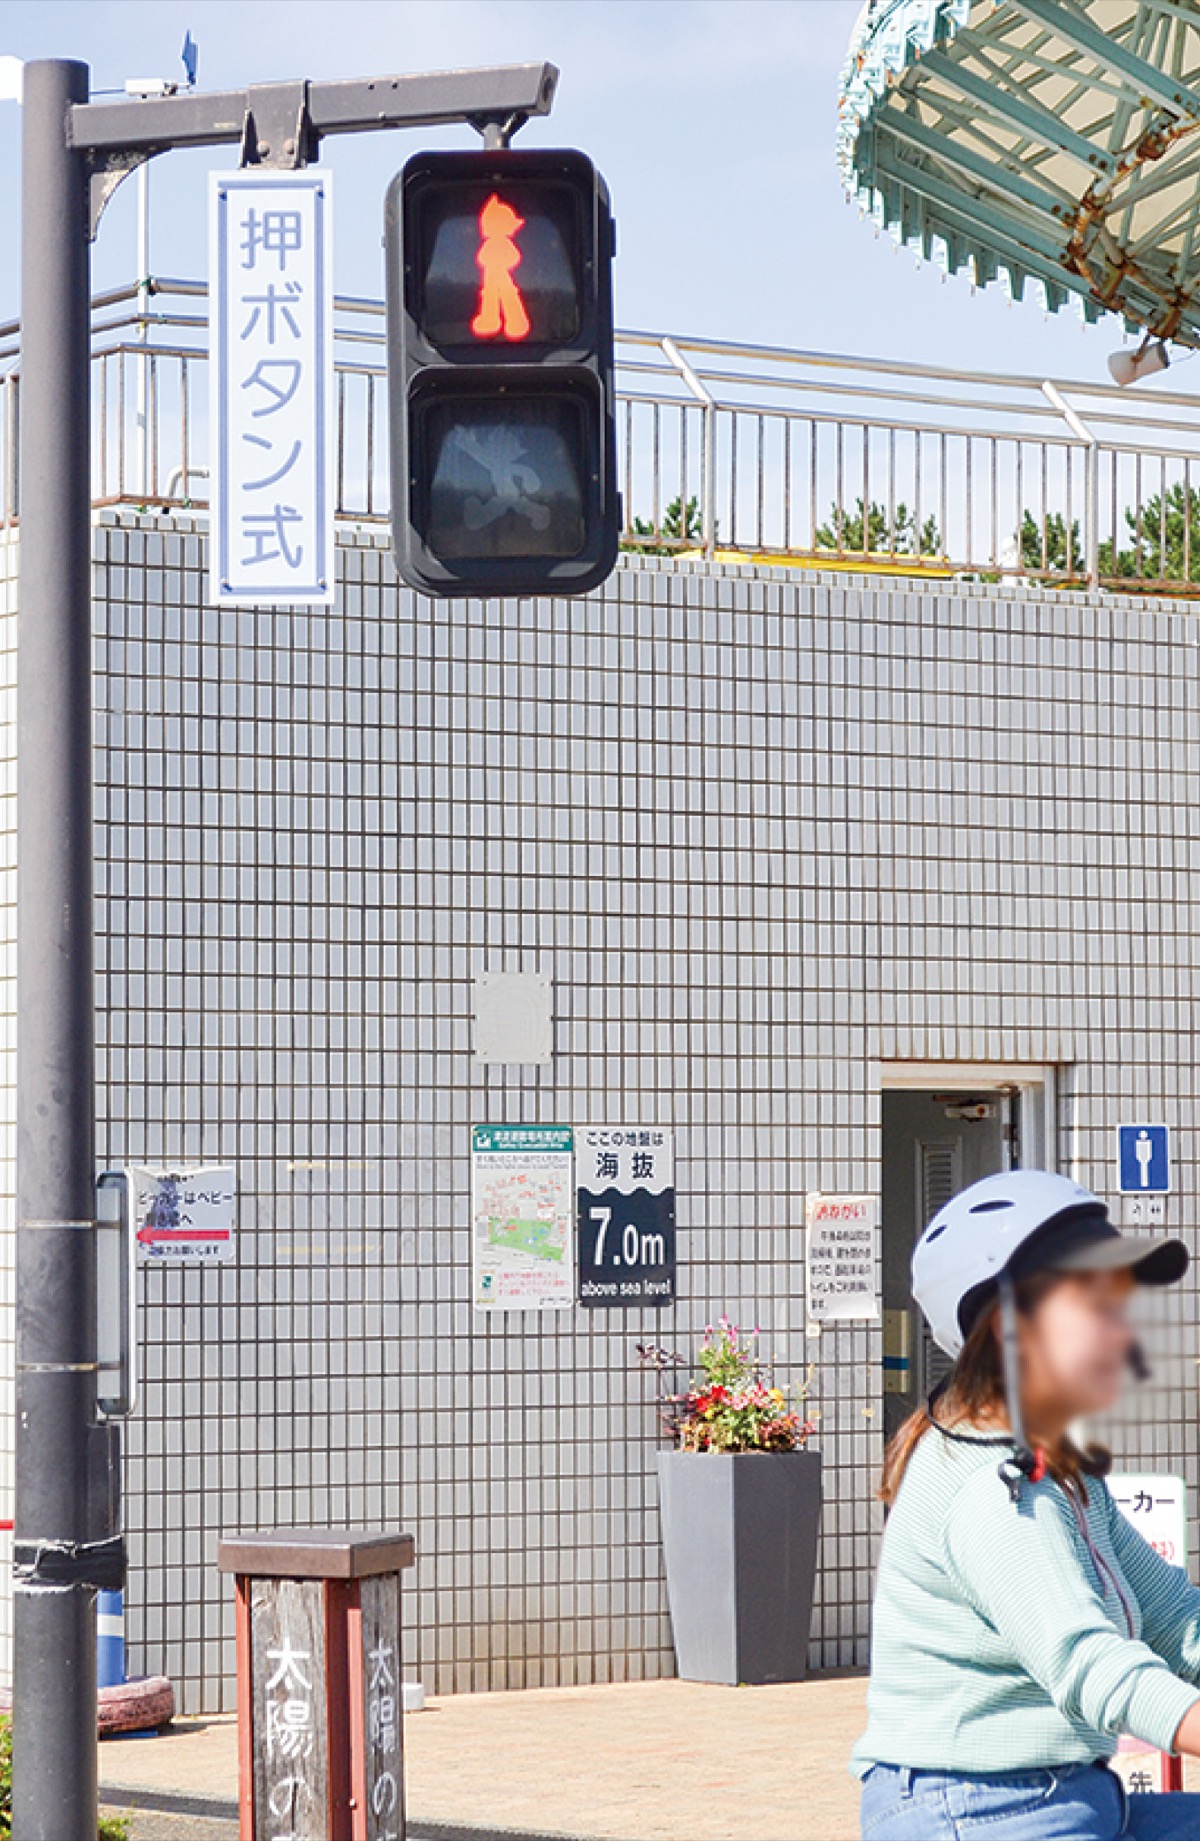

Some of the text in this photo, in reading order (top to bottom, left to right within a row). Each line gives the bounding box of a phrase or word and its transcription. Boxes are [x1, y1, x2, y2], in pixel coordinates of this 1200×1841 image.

[240, 207, 304, 570] 押ボタン式
[586, 1130, 664, 1147] ここの地盤は
[581, 1279, 618, 1297] above
[619, 1281, 641, 1296] sea
[643, 1278, 671, 1295] level
[589, 1207, 664, 1266] 7.0m
[264, 1637, 313, 1841] 太陽の
[368, 1637, 398, 1841] 太陽の
